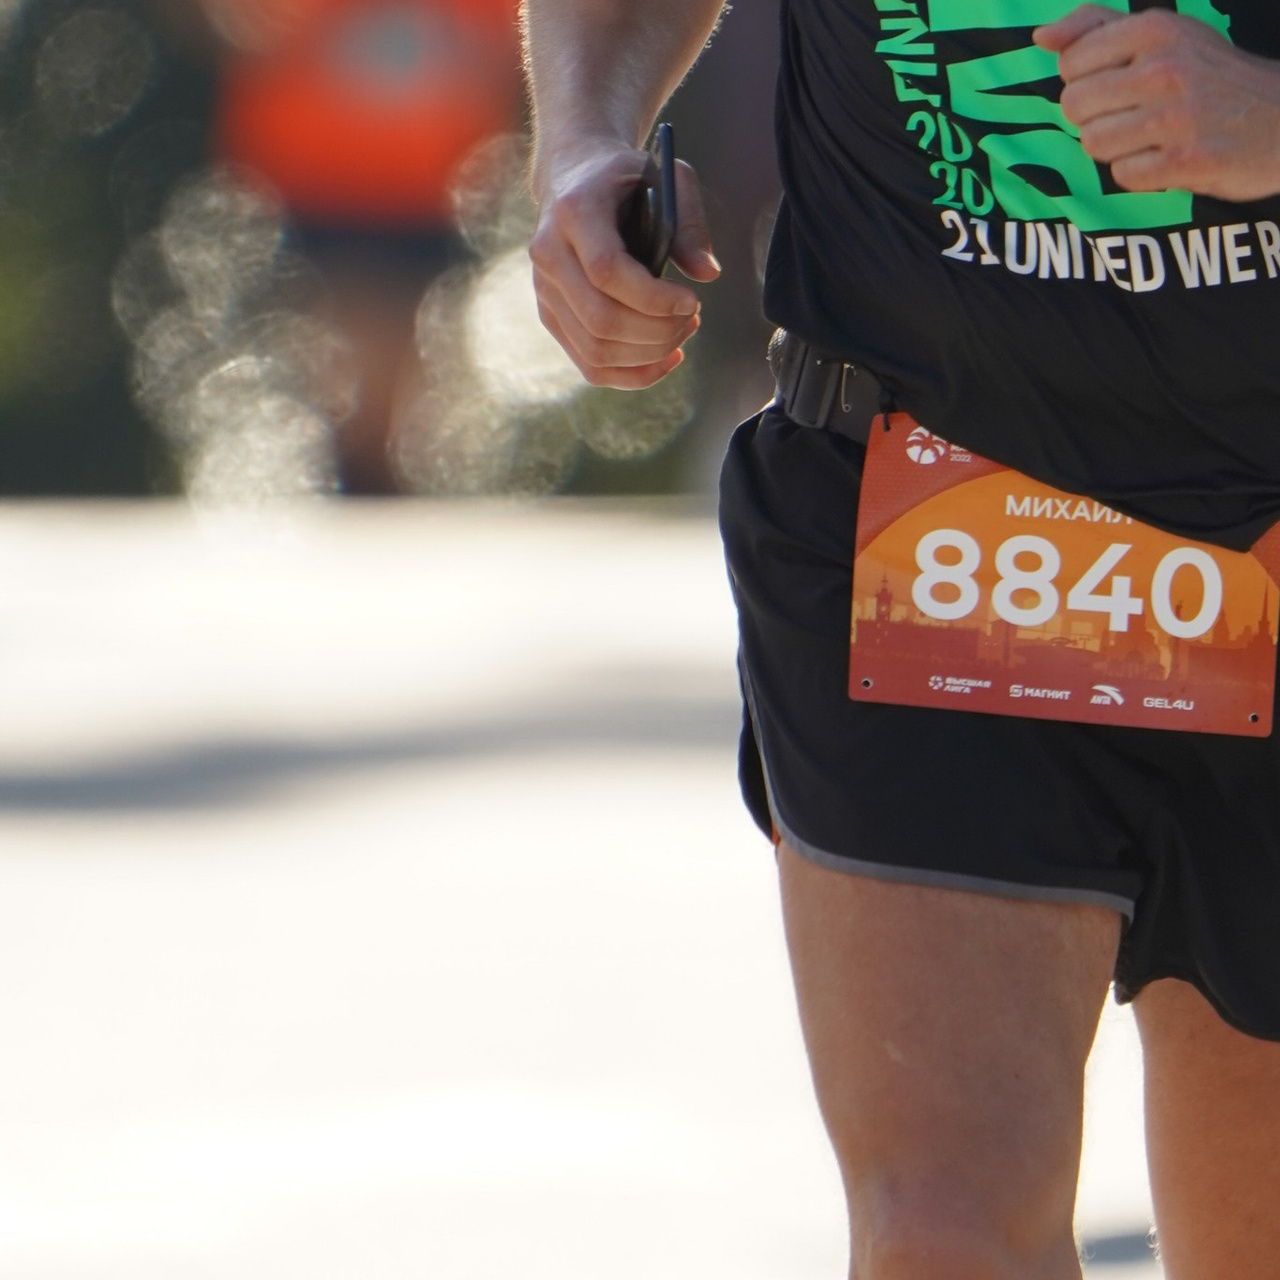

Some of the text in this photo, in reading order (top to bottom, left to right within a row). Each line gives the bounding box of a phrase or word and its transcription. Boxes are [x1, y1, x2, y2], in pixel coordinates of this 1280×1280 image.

[940, 209, 1001, 265] 21
[1005, 221, 1166, 293] UNITED
[1167, 222, 1257, 289] WE
[911, 528, 1223, 640] 8840
[1024, 687, 1071, 700] МАГНИТ
[1143, 696, 1195, 711] GEL4U
